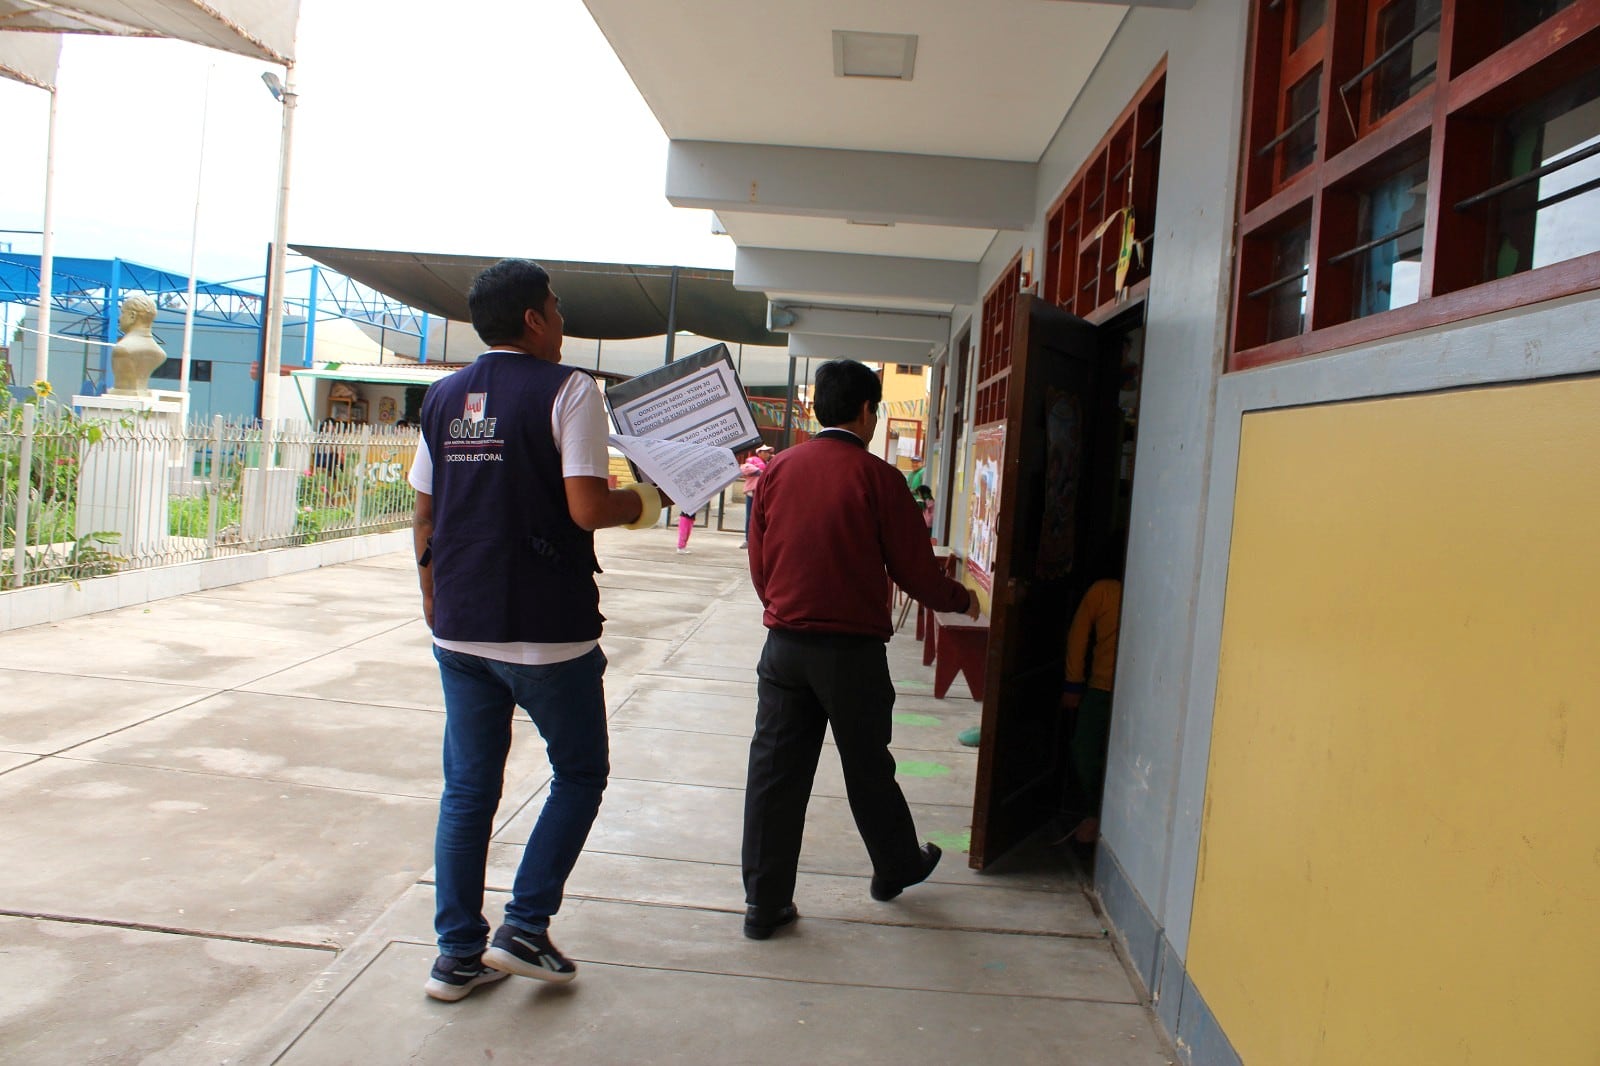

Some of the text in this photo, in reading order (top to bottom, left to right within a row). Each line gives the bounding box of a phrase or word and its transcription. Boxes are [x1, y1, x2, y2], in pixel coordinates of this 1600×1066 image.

[686, 384, 702, 394] MESA
[706, 384, 720, 393] LISTA
[668, 392, 683, 402] ODPE
[670, 390, 706, 410] PROVISIONAL
[638, 399, 668, 416] MOLLENDO
[449, 417, 497, 439] ONPE
[703, 422, 718, 432] MESA
[723, 422, 737, 431] LISTA
[692, 428, 723, 445] PROVISION
[714, 430, 738, 443] DISTRITO
[444, 453, 504, 462] OCESO ELECTORAL
